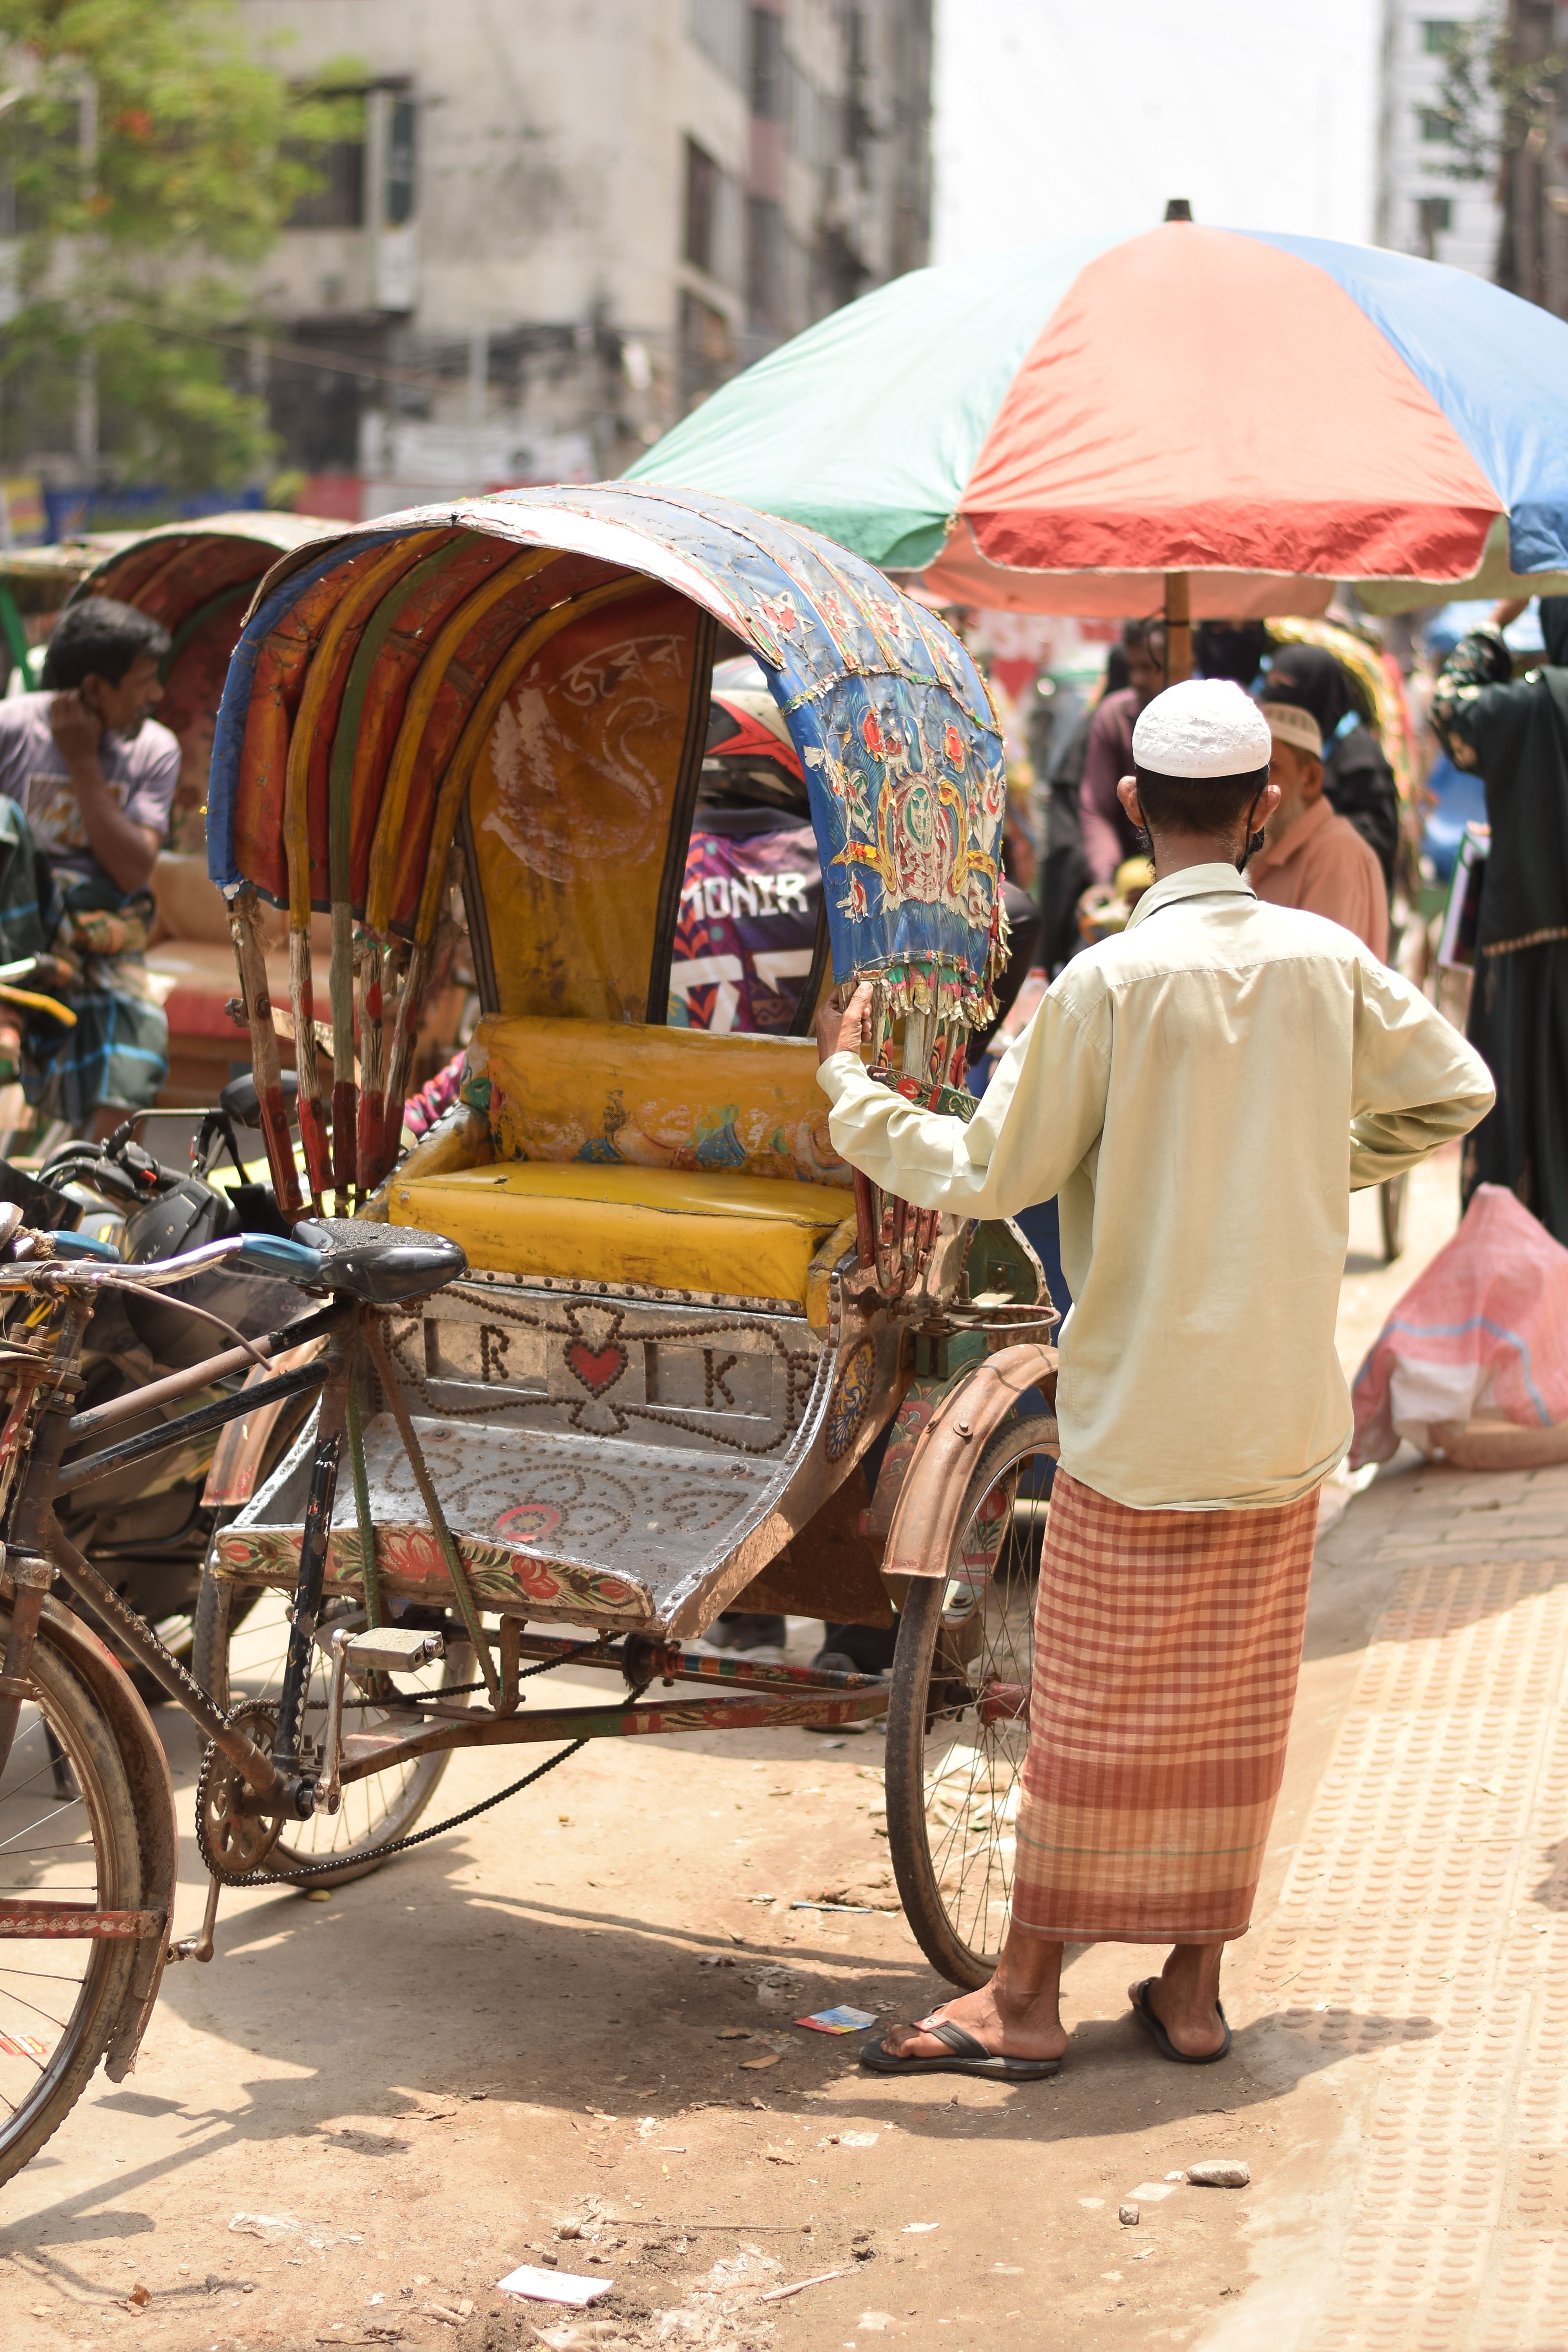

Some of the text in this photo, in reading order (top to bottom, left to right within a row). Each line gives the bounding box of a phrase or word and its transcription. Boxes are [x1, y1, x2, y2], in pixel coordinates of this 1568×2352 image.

[677, 872, 808, 923] MONIR
[480, 1325, 510, 1382] R
[703, 1348, 737, 1407] K
[62, 2040, 94, 2090] GOLD
